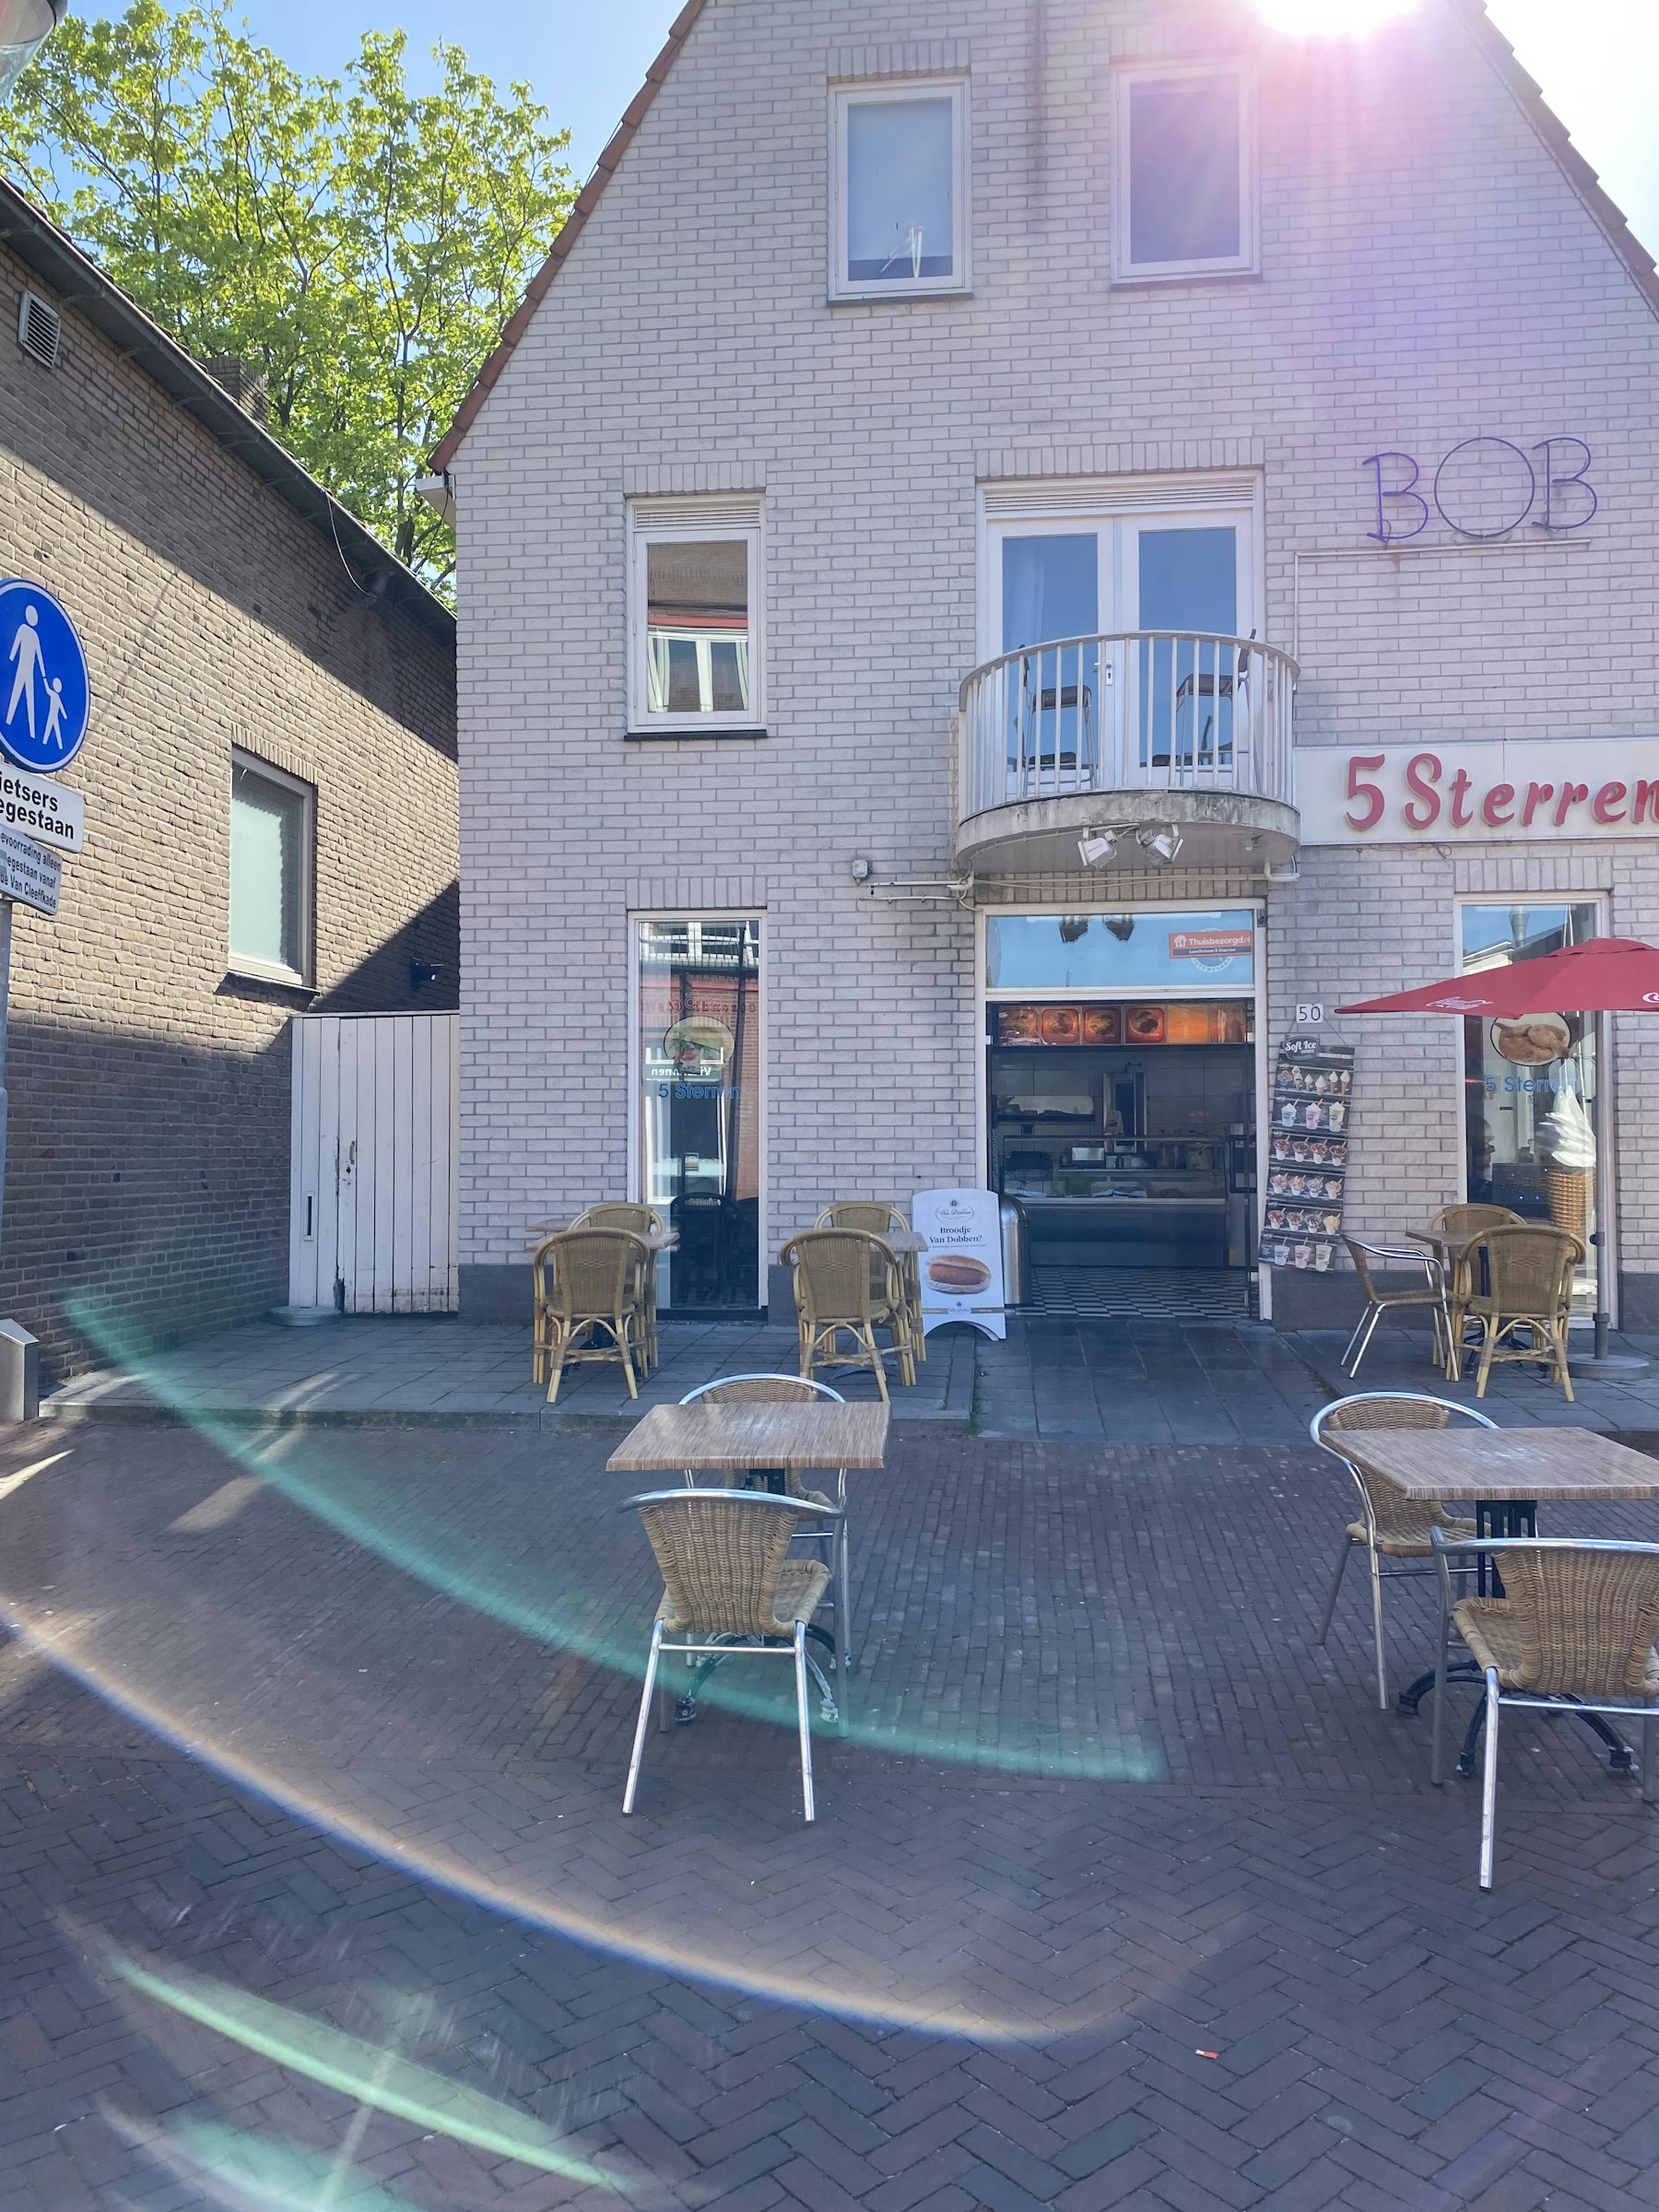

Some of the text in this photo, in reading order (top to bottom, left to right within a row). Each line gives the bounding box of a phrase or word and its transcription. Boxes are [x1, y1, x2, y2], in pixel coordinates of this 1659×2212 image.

[1362, 437, 1597, 542] BOB
[1403, 753, 1659, 829] Sterren
[42, 854, 61, 873] alleen
[10, 874, 23, 892] Van
[40, 872, 56, 889] vanaf
[1189, 935, 1251, 946] Thuisbezorgd.nl
[1299, 1006, 1321, 1021] 50
[1286, 1041, 1316, 1053] Soft Ice
[940, 1226, 971, 1235] Broodje
[947, 1235, 982, 1243] Dobben?
